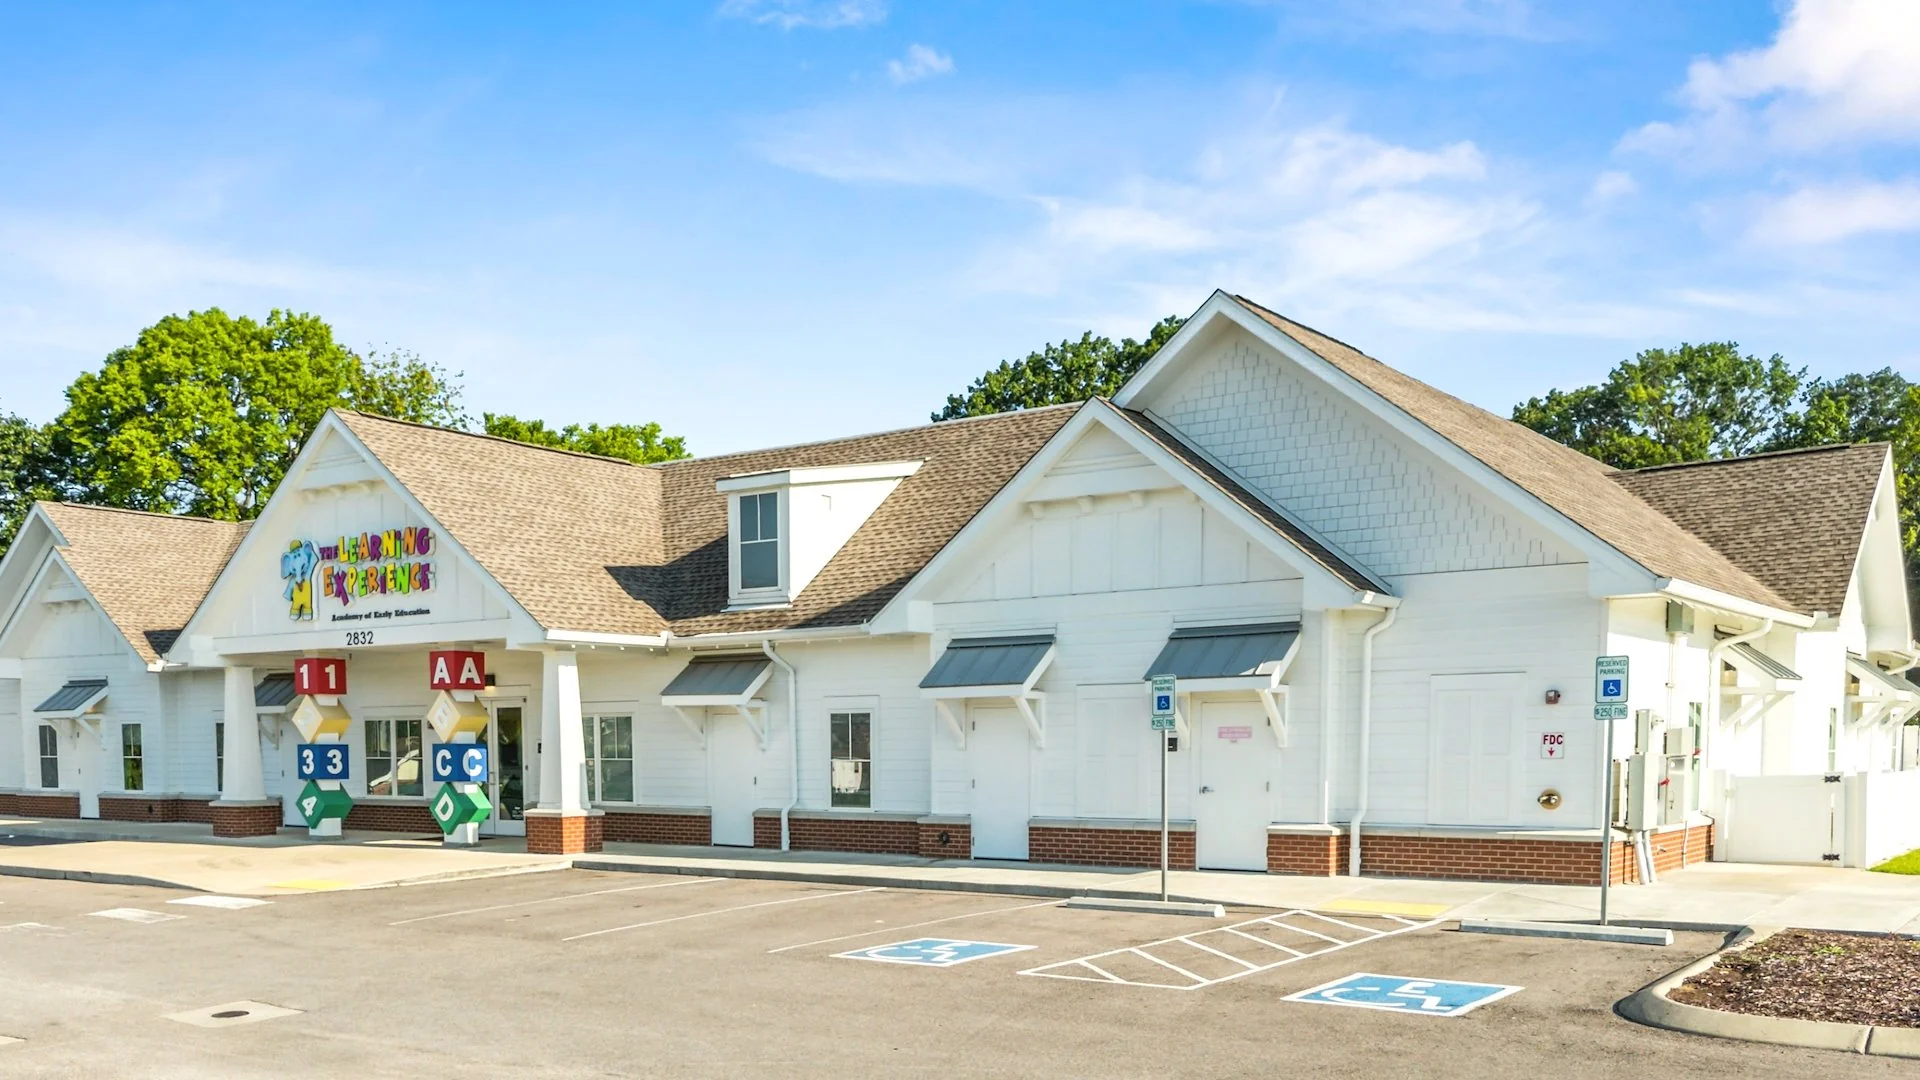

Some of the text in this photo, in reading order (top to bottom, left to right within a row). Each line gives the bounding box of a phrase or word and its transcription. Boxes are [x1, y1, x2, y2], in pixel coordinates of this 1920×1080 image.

[319, 545, 339, 561] THE
[331, 607, 431, 621] Academy of Early Education
[346, 630, 374, 646] 2832
[299, 663, 309, 689] 1
[324, 663, 337, 689] 1
[433, 656, 451, 684] A
[459, 656, 481, 684] A
[1614, 707, 1627, 716] FINE
[1543, 734, 1564, 745] FDC
[302, 748, 315, 775] 3
[326, 748, 343, 775] 3
[436, 748, 453, 777] C
[462, 748, 483, 777] C
[301, 795, 318, 818] 4
[434, 792, 454, 822] D
